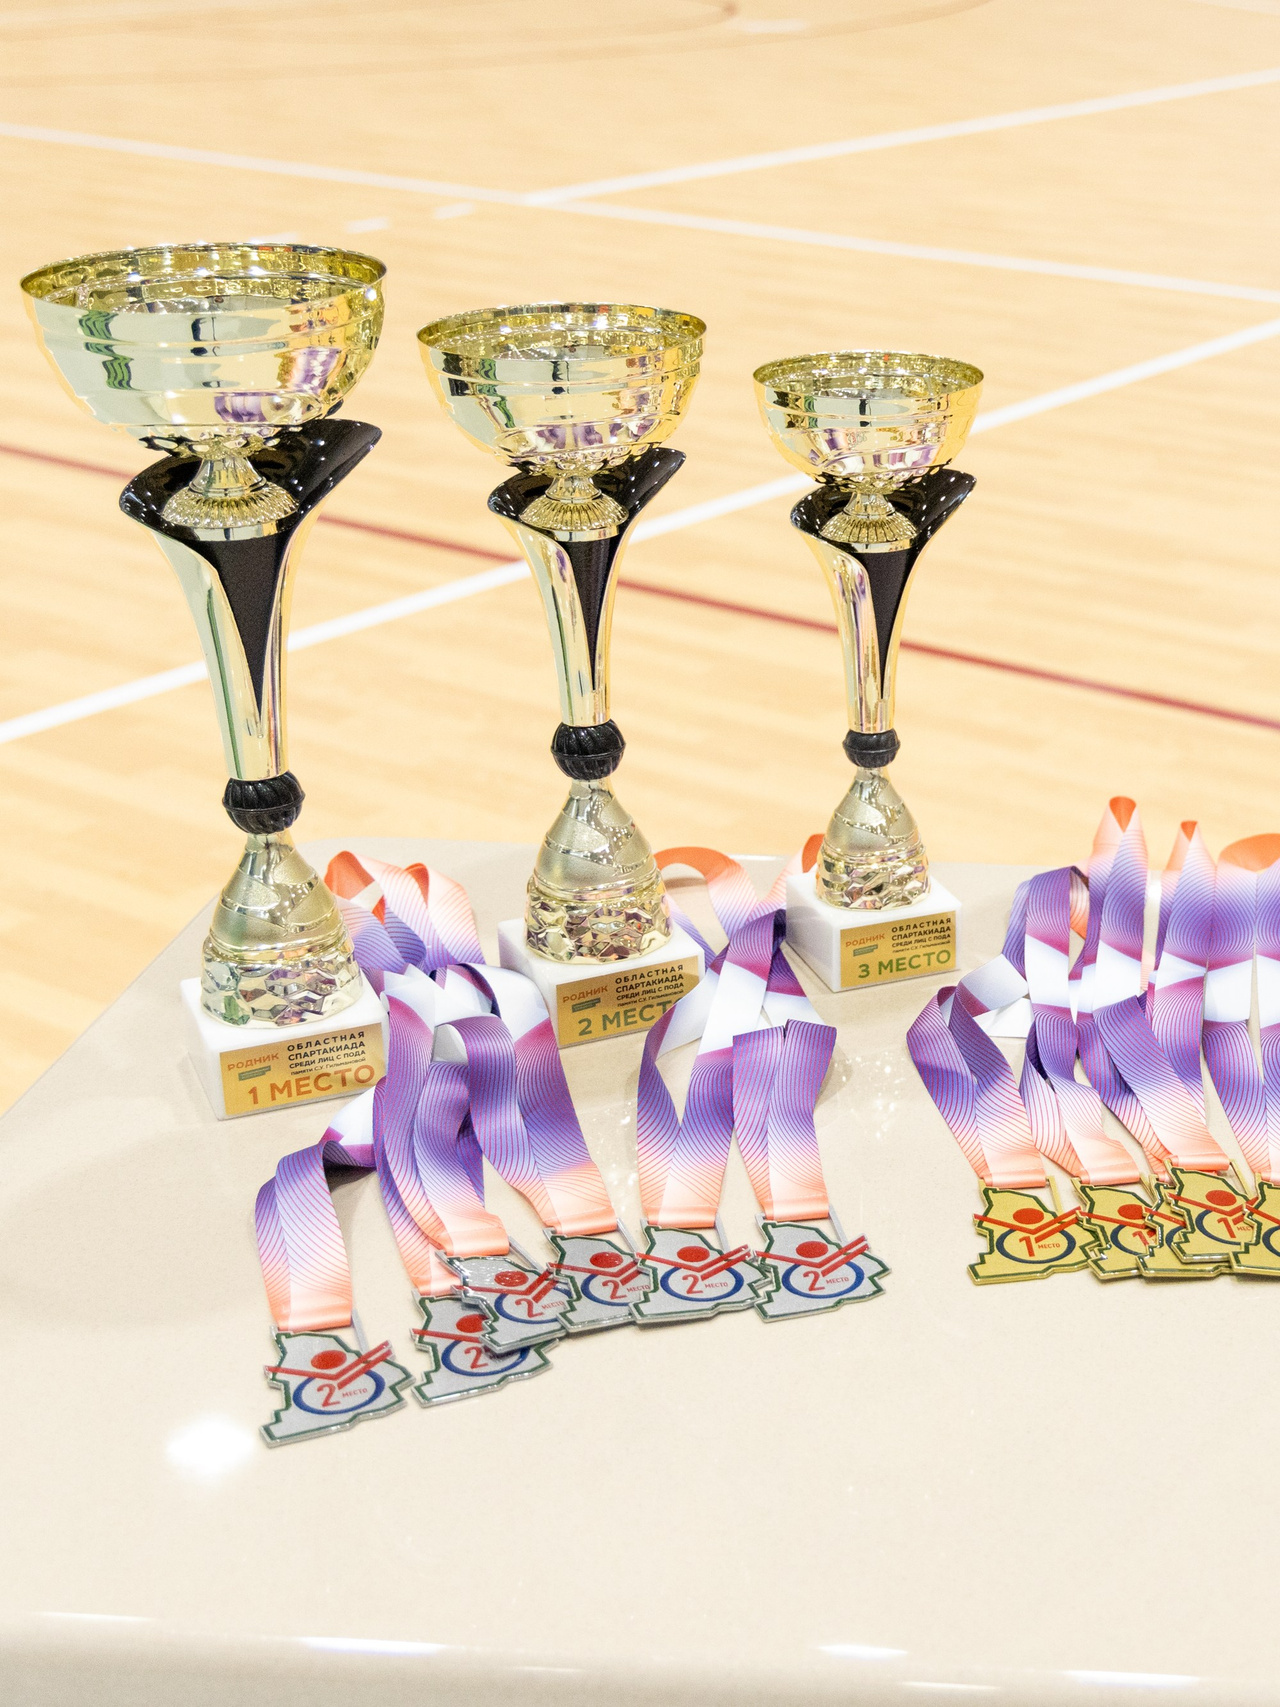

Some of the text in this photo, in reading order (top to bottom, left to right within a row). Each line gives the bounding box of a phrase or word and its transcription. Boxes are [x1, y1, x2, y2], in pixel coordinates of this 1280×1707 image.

[892, 918, 951, 932] ОБЛАСТНАЯ
[892, 926, 951, 940] СПАРТАКИАДА
[846, 933, 885, 948] РОДНИК
[858, 964, 870, 978] 3
[878, 949, 951, 975] МЕСТО
[615, 964, 683, 984] ОБЛАСТНАЯ
[616, 974, 684, 993] СПАРТАКИАДА
[562, 985, 608, 1004] РОДНИК
[616, 992, 640, 1000] СРЕДИ
[578, 1018, 592, 1036] 2
[602, 998, 682, 1031] МЕСТ
[287, 1031, 365, 1052] ОБЛАСТНАЯ
[288, 1041, 366, 1061] СПАРТАКИАДА
[227, 1052, 279, 1072] РОДНИК
[289, 1059, 316, 1069] СРЕДИ
[344, 1050, 366, 1058] ПОДА
[248, 1086, 259, 1105] 1
[270, 1064, 375, 1101] МЕСТО
[1217, 1218, 1236, 1238] 1
[1018, 1236, 1036, 1258] 1
[602, 1280, 650, 1300] 2 МЕСТО
[682, 1274, 704, 1294] 2
[803, 1270, 849, 1292] 2 МЕСТО
[514, 1298, 565, 1318] 2 МЕСТО
[464, 1346, 488, 1369] 2
[316, 1384, 368, 1408] 2 МЕСТО
